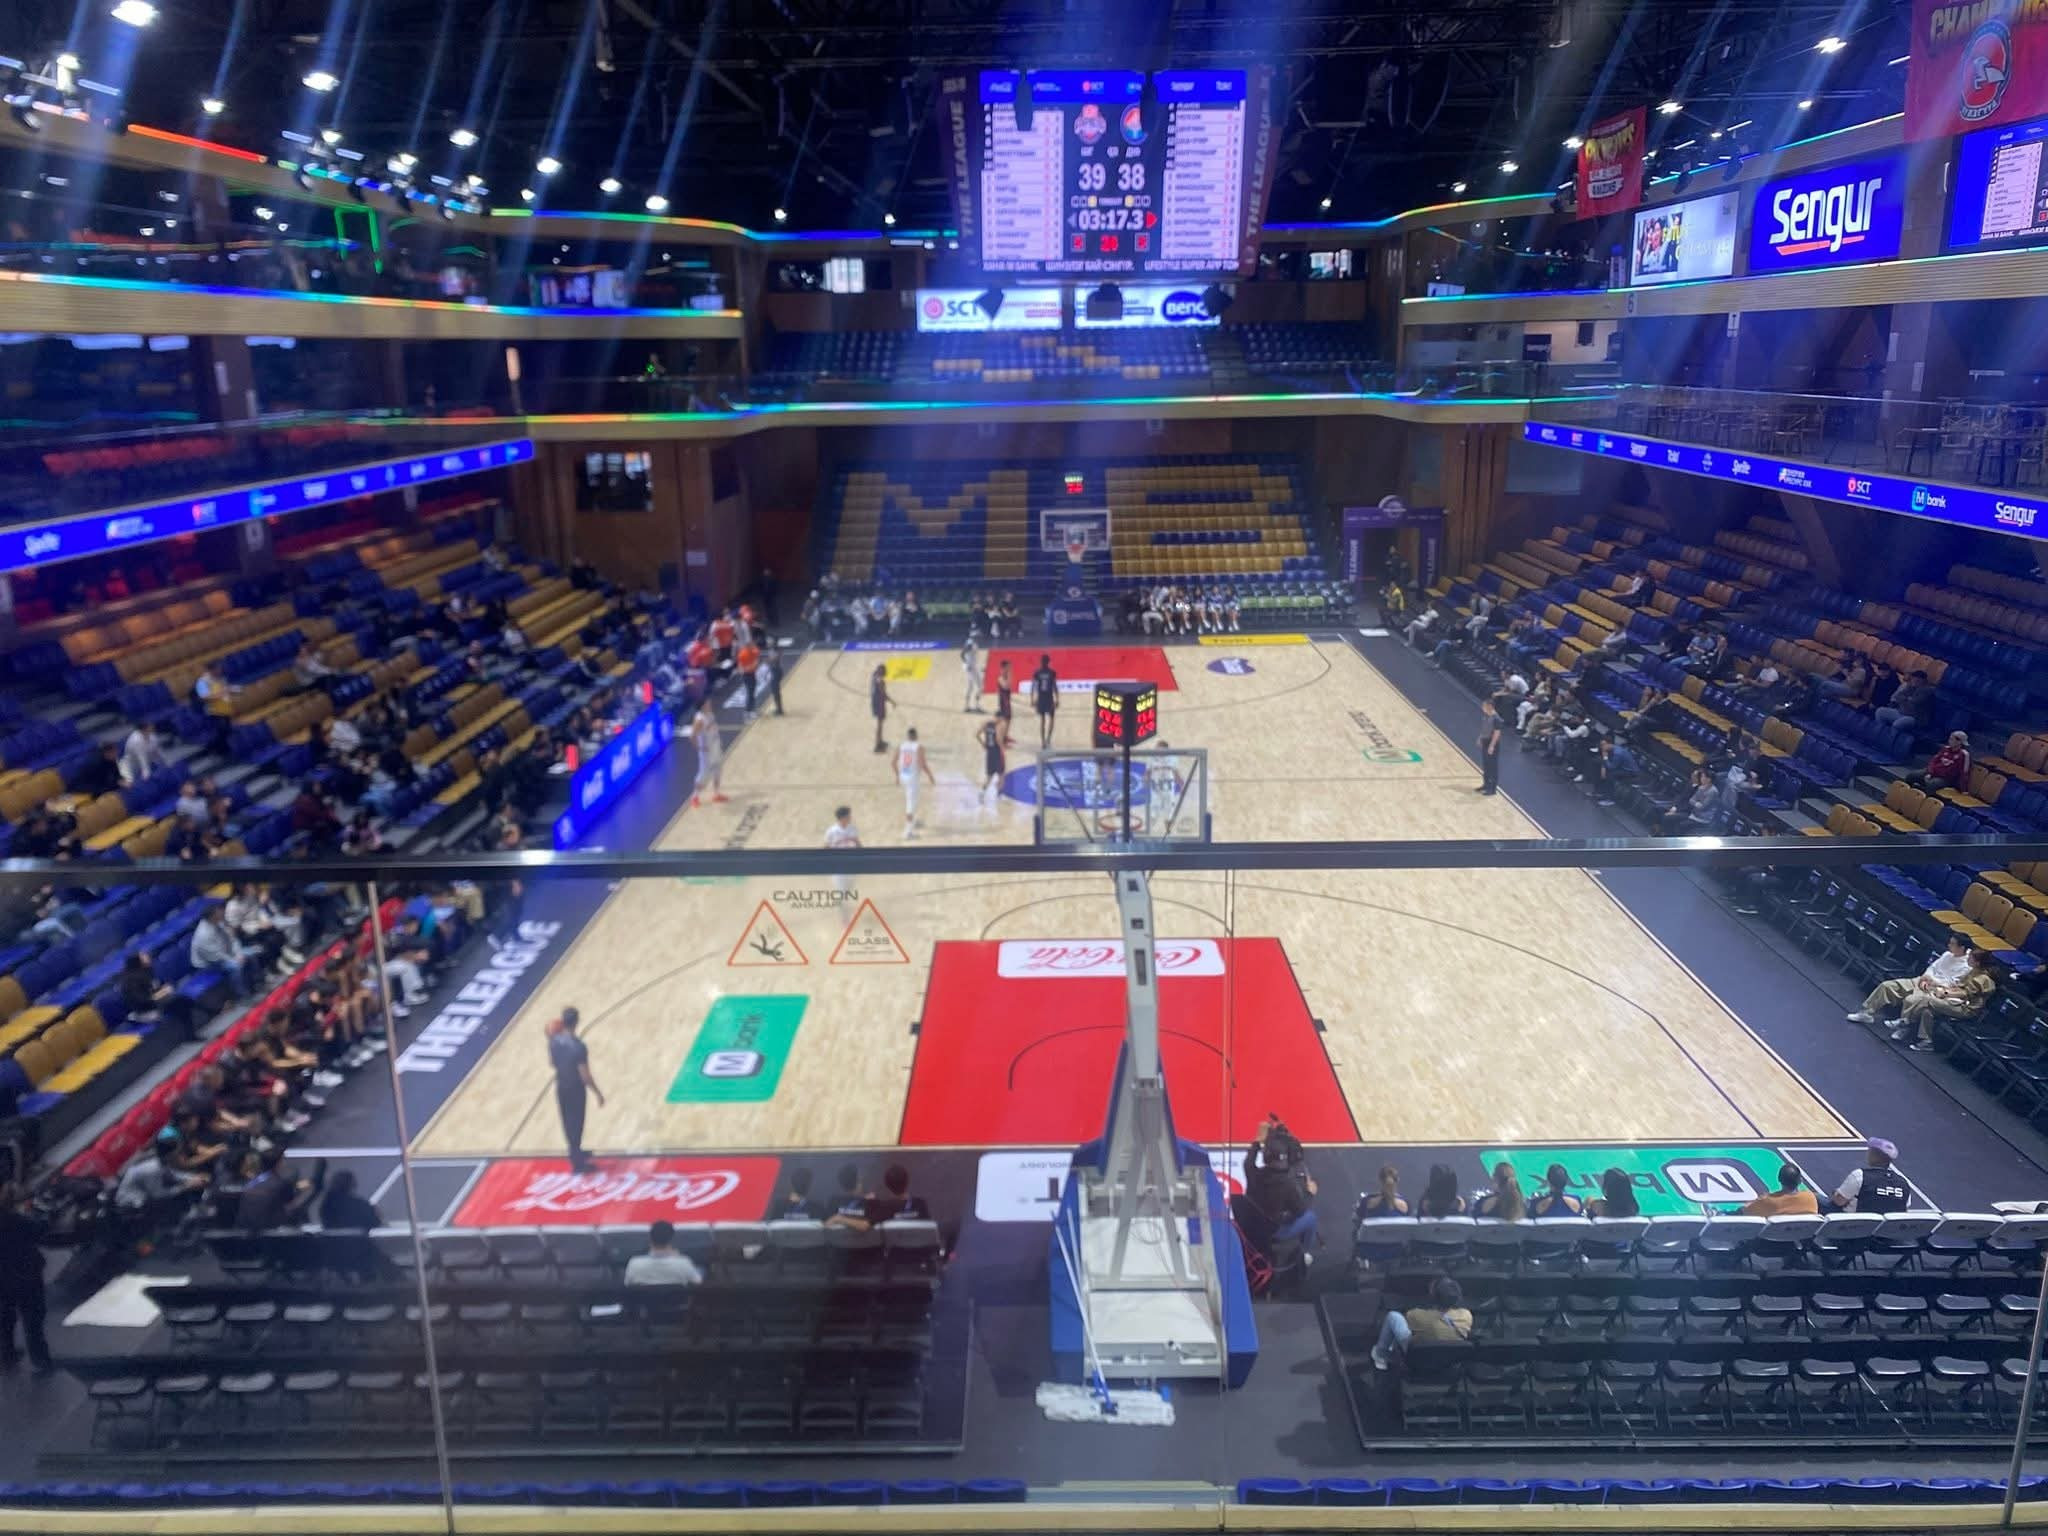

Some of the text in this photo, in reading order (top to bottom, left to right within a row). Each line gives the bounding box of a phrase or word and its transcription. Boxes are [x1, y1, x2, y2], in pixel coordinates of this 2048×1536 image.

[1079, 163, 1145, 190] 39 38
[1078, 209, 1144, 230] 03:17.3
[1769, 178, 1882, 253] Sengur
[1857, 481, 1872, 494] SCT
[1994, 501, 2037, 527] Sengur
[773, 889, 859, 901] CAUTION
[848, 937, 890, 945] GLASS
[1680, 1172, 1744, 1193] M
